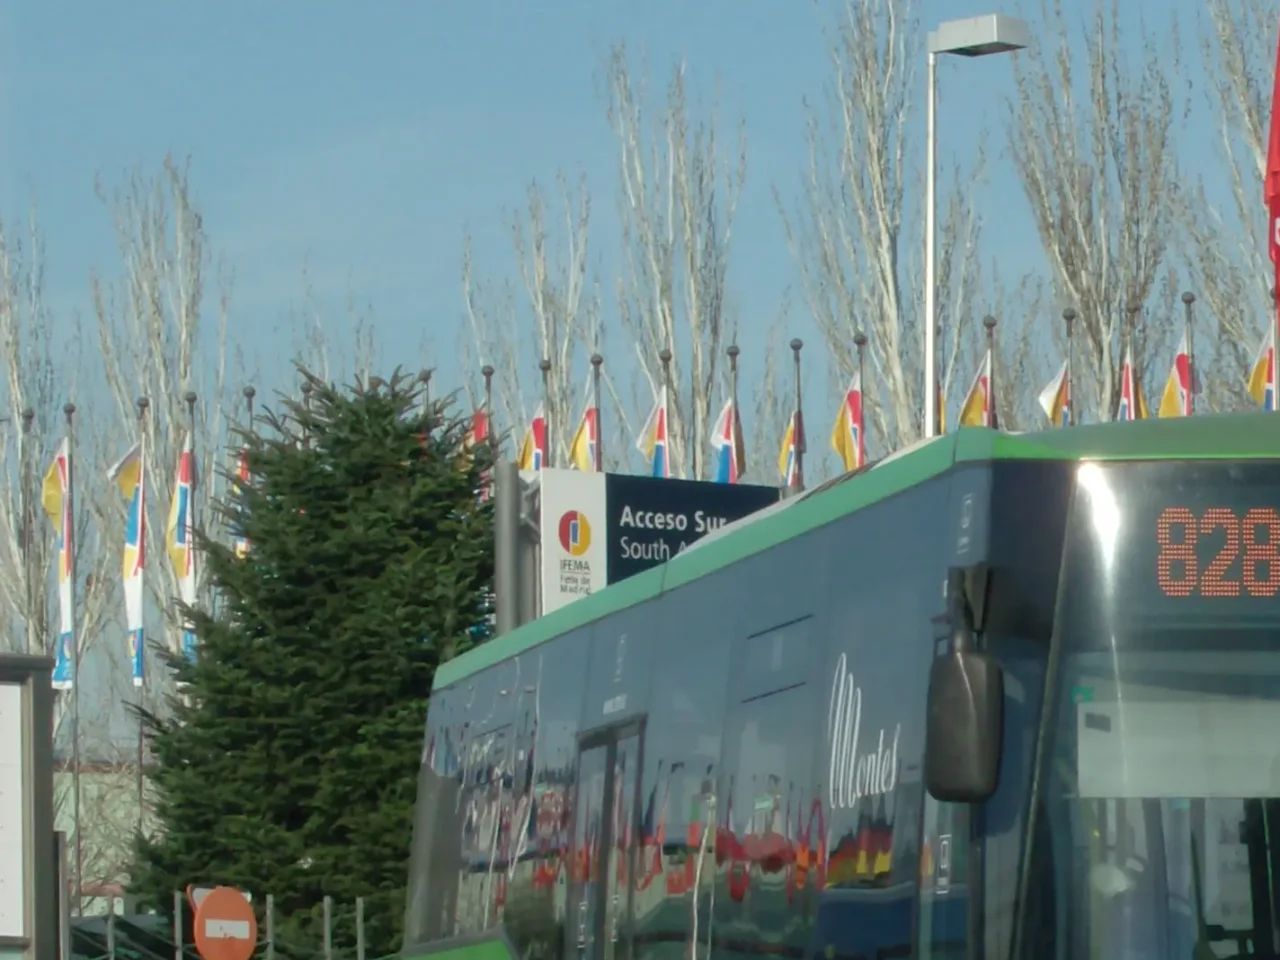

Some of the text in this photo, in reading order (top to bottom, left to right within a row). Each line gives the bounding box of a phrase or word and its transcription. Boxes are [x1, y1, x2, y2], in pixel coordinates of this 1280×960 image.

[619, 505, 728, 533] Acceso Sur
[620, 536, 670, 561] South
[560, 559, 590, 571] IFEMA
